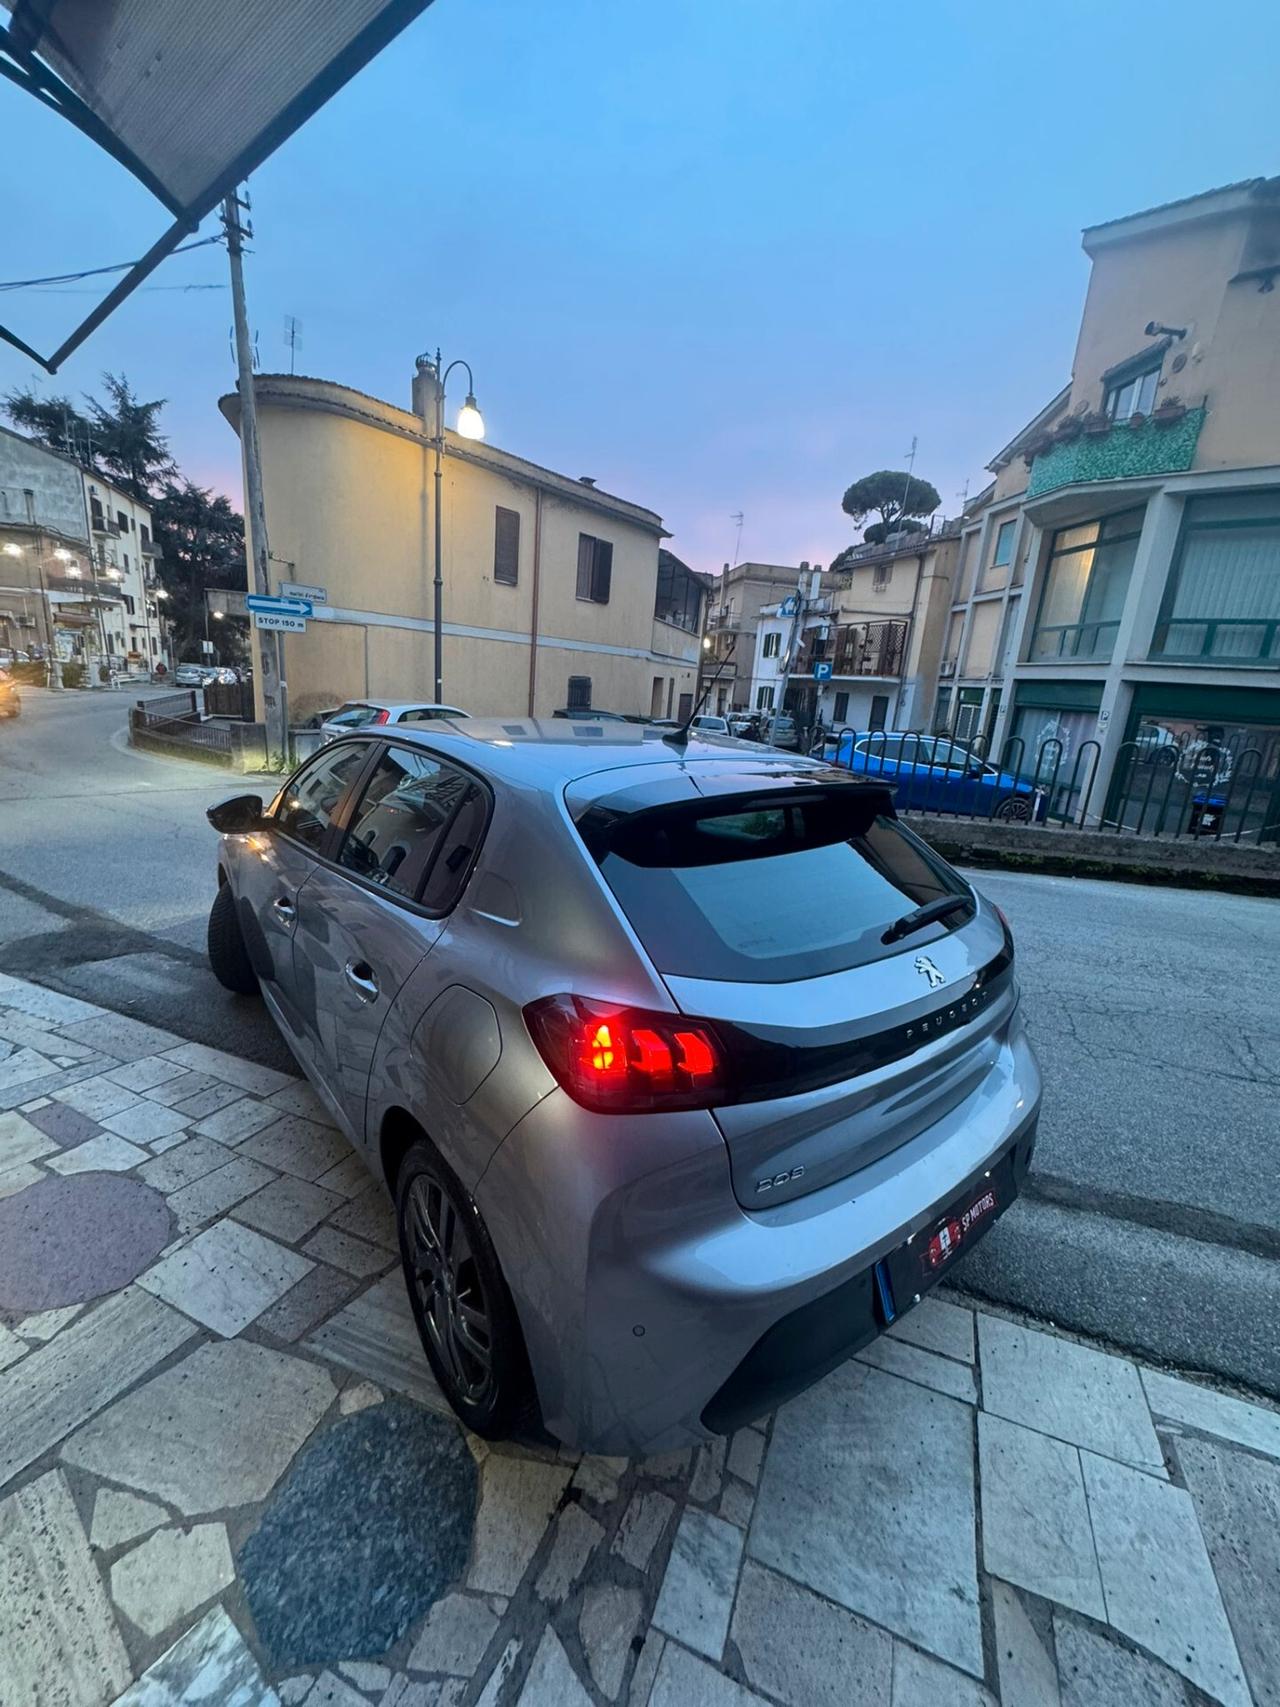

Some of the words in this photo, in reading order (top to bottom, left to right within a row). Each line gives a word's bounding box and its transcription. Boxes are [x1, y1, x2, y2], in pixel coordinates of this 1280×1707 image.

[258, 616, 280, 625] STOP
[281, 619, 296, 628] 150
[817, 664, 829, 678] P
[906, 991, 988, 1039] PEUGEOT
[756, 1165, 805, 1193] 208
[961, 1212, 970, 1232] SP
[969, 1192, 995, 1222] MOTORS
